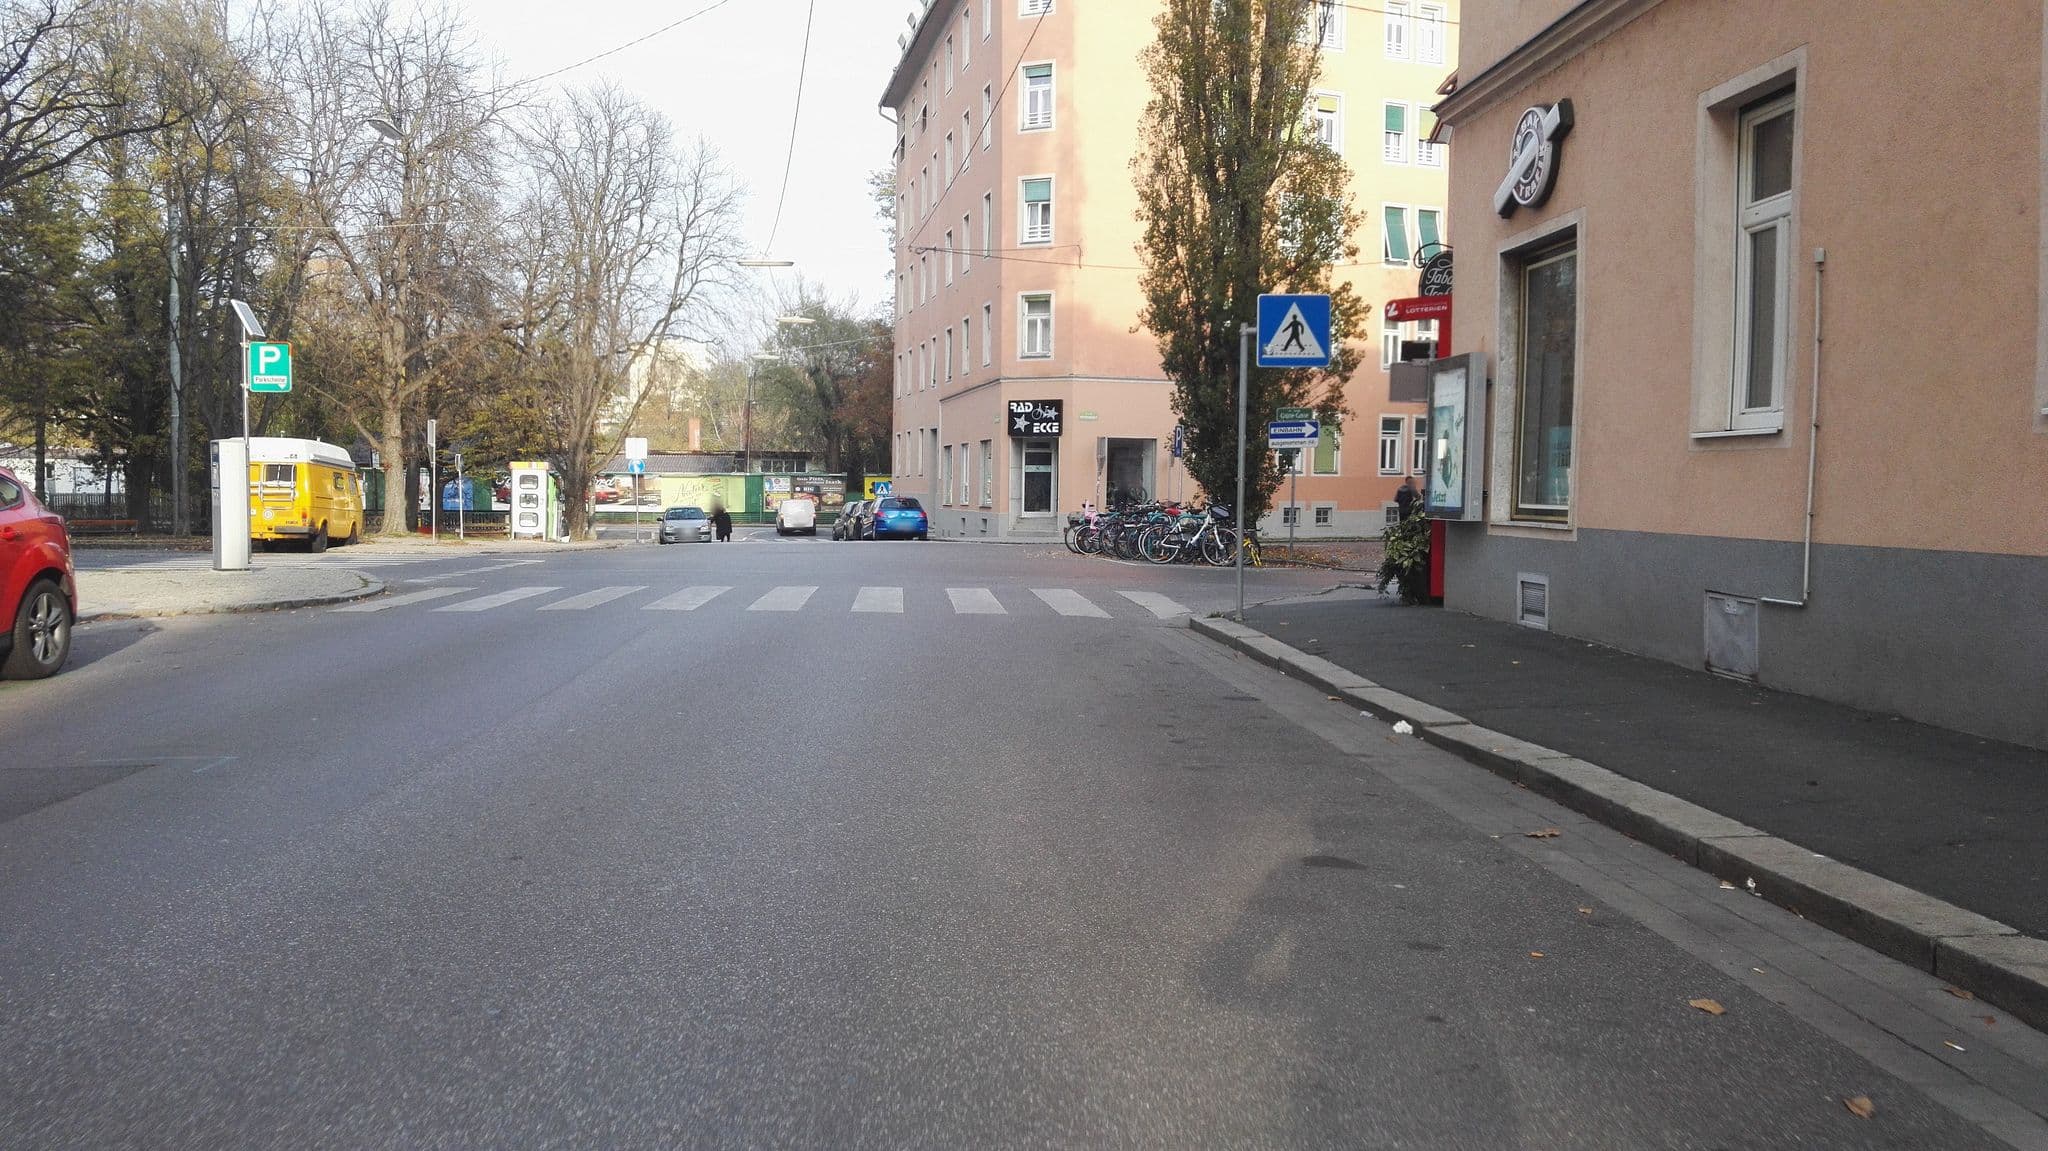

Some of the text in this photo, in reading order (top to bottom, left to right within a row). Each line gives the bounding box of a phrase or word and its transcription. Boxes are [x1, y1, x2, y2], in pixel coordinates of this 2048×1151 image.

[1426, 267, 1454, 285] Taba
[1406, 305, 1448, 314] LOTTERIEN
[259, 345, 281, 375] P
[1009, 402, 1034, 413] RAD
[1033, 422, 1060, 433] ECKE
